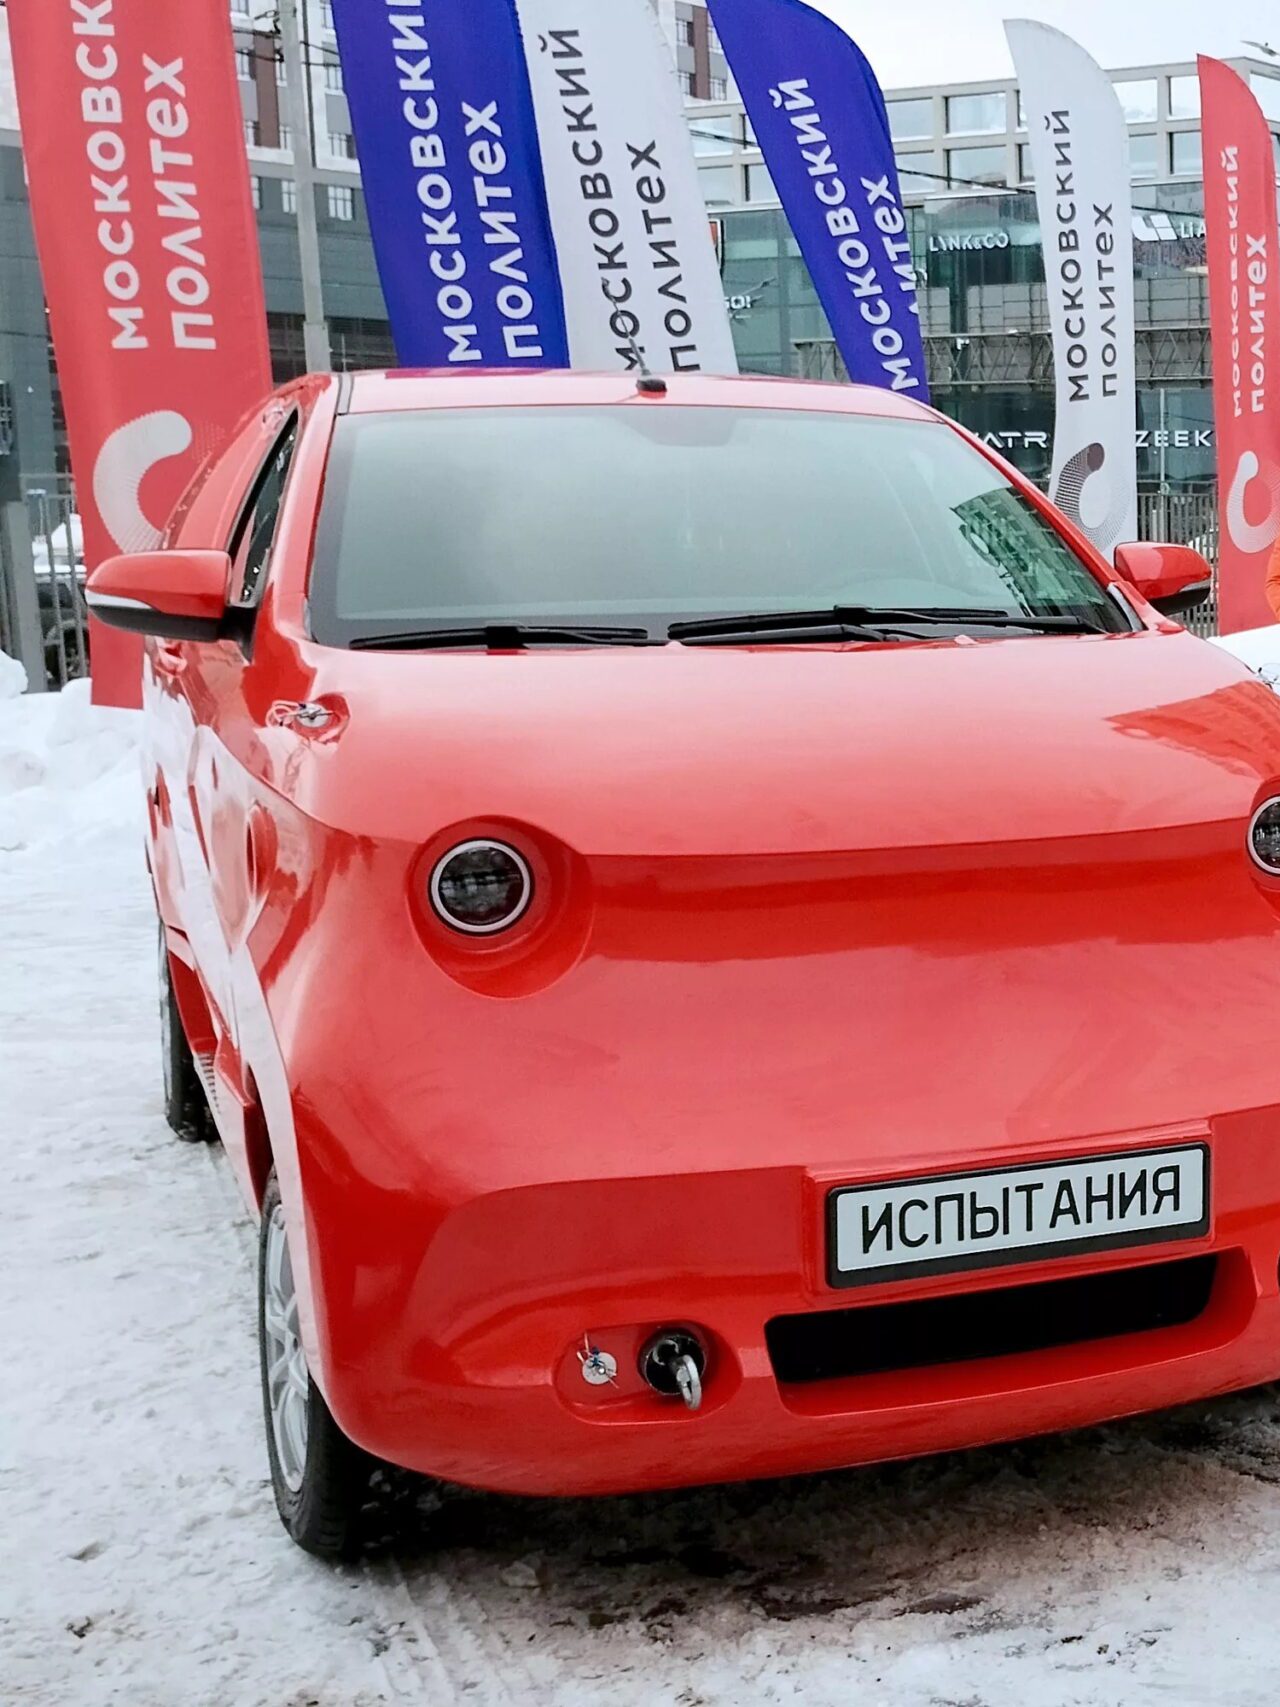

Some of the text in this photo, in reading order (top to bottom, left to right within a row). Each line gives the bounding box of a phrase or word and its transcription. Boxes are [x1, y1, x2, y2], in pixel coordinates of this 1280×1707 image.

[69, 0, 149, 350] МОСКОВСК
[388, 0, 483, 363] МОСКОВСКИ
[537, 29, 647, 371] МОСКОВСКИЙ
[768, 78, 920, 391] МОСКОВСКИЙ
[1044, 110, 1090, 402] МОСКОВСКИЙ
[1221, 146, 1242, 418] МОСКОВСКИЙ
[974, 431, 1048, 449] ATR
[1134, 430, 1213, 447] ZEEK
[861, 1164, 1181, 1255] ИСПЫТАНИЯ
